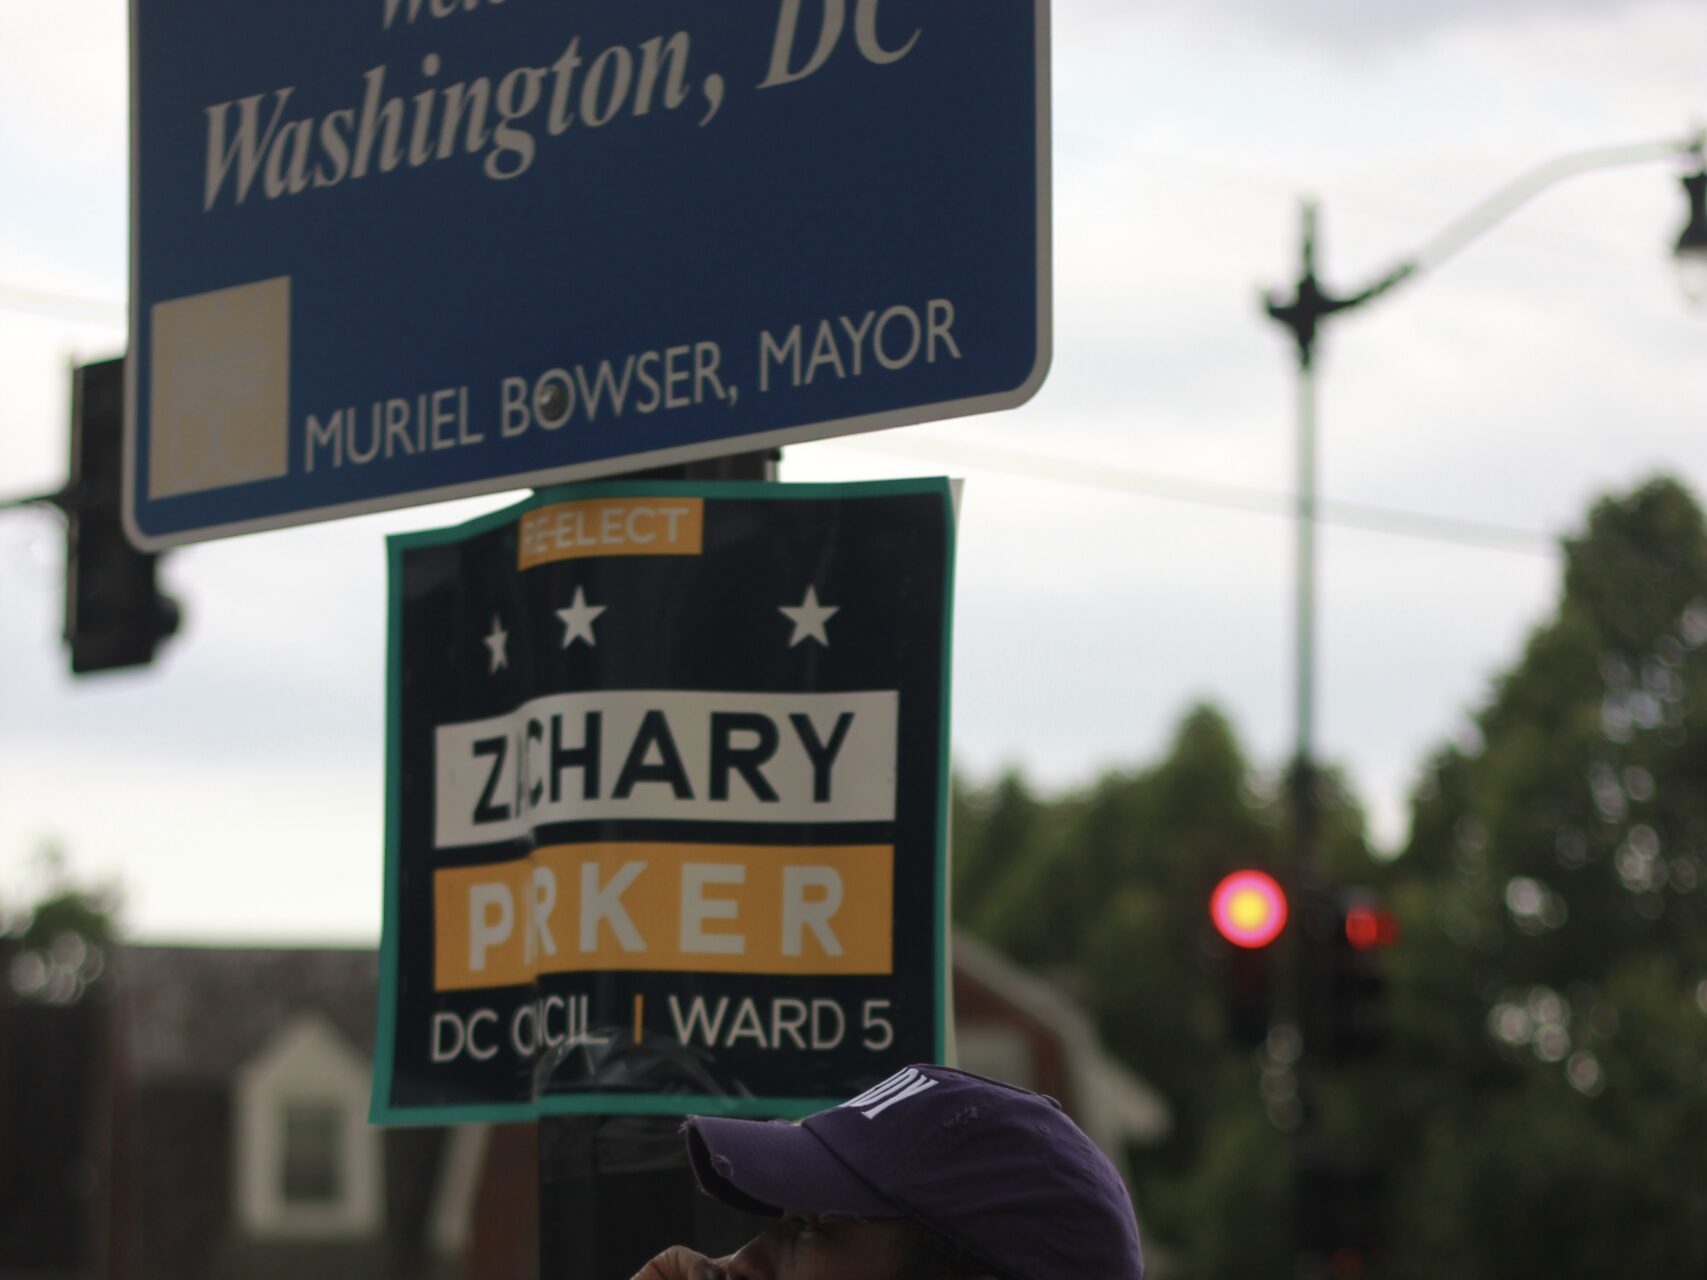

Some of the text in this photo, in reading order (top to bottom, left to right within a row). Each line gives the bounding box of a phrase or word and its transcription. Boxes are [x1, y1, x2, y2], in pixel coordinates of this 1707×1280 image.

[203, 30, 727, 212] Washington,
[304, 386, 484, 473] MURIEL
[500, 341, 739, 438] BOWSER,
[759, 298, 963, 392] MAYOR
[472, 709, 856, 826] ZCHARY
[468, 860, 844, 973] PRKER
[431, 1008, 499, 1063] DC
[668, 994, 846, 1050] WARD
[863, 999, 894, 1051] 5
